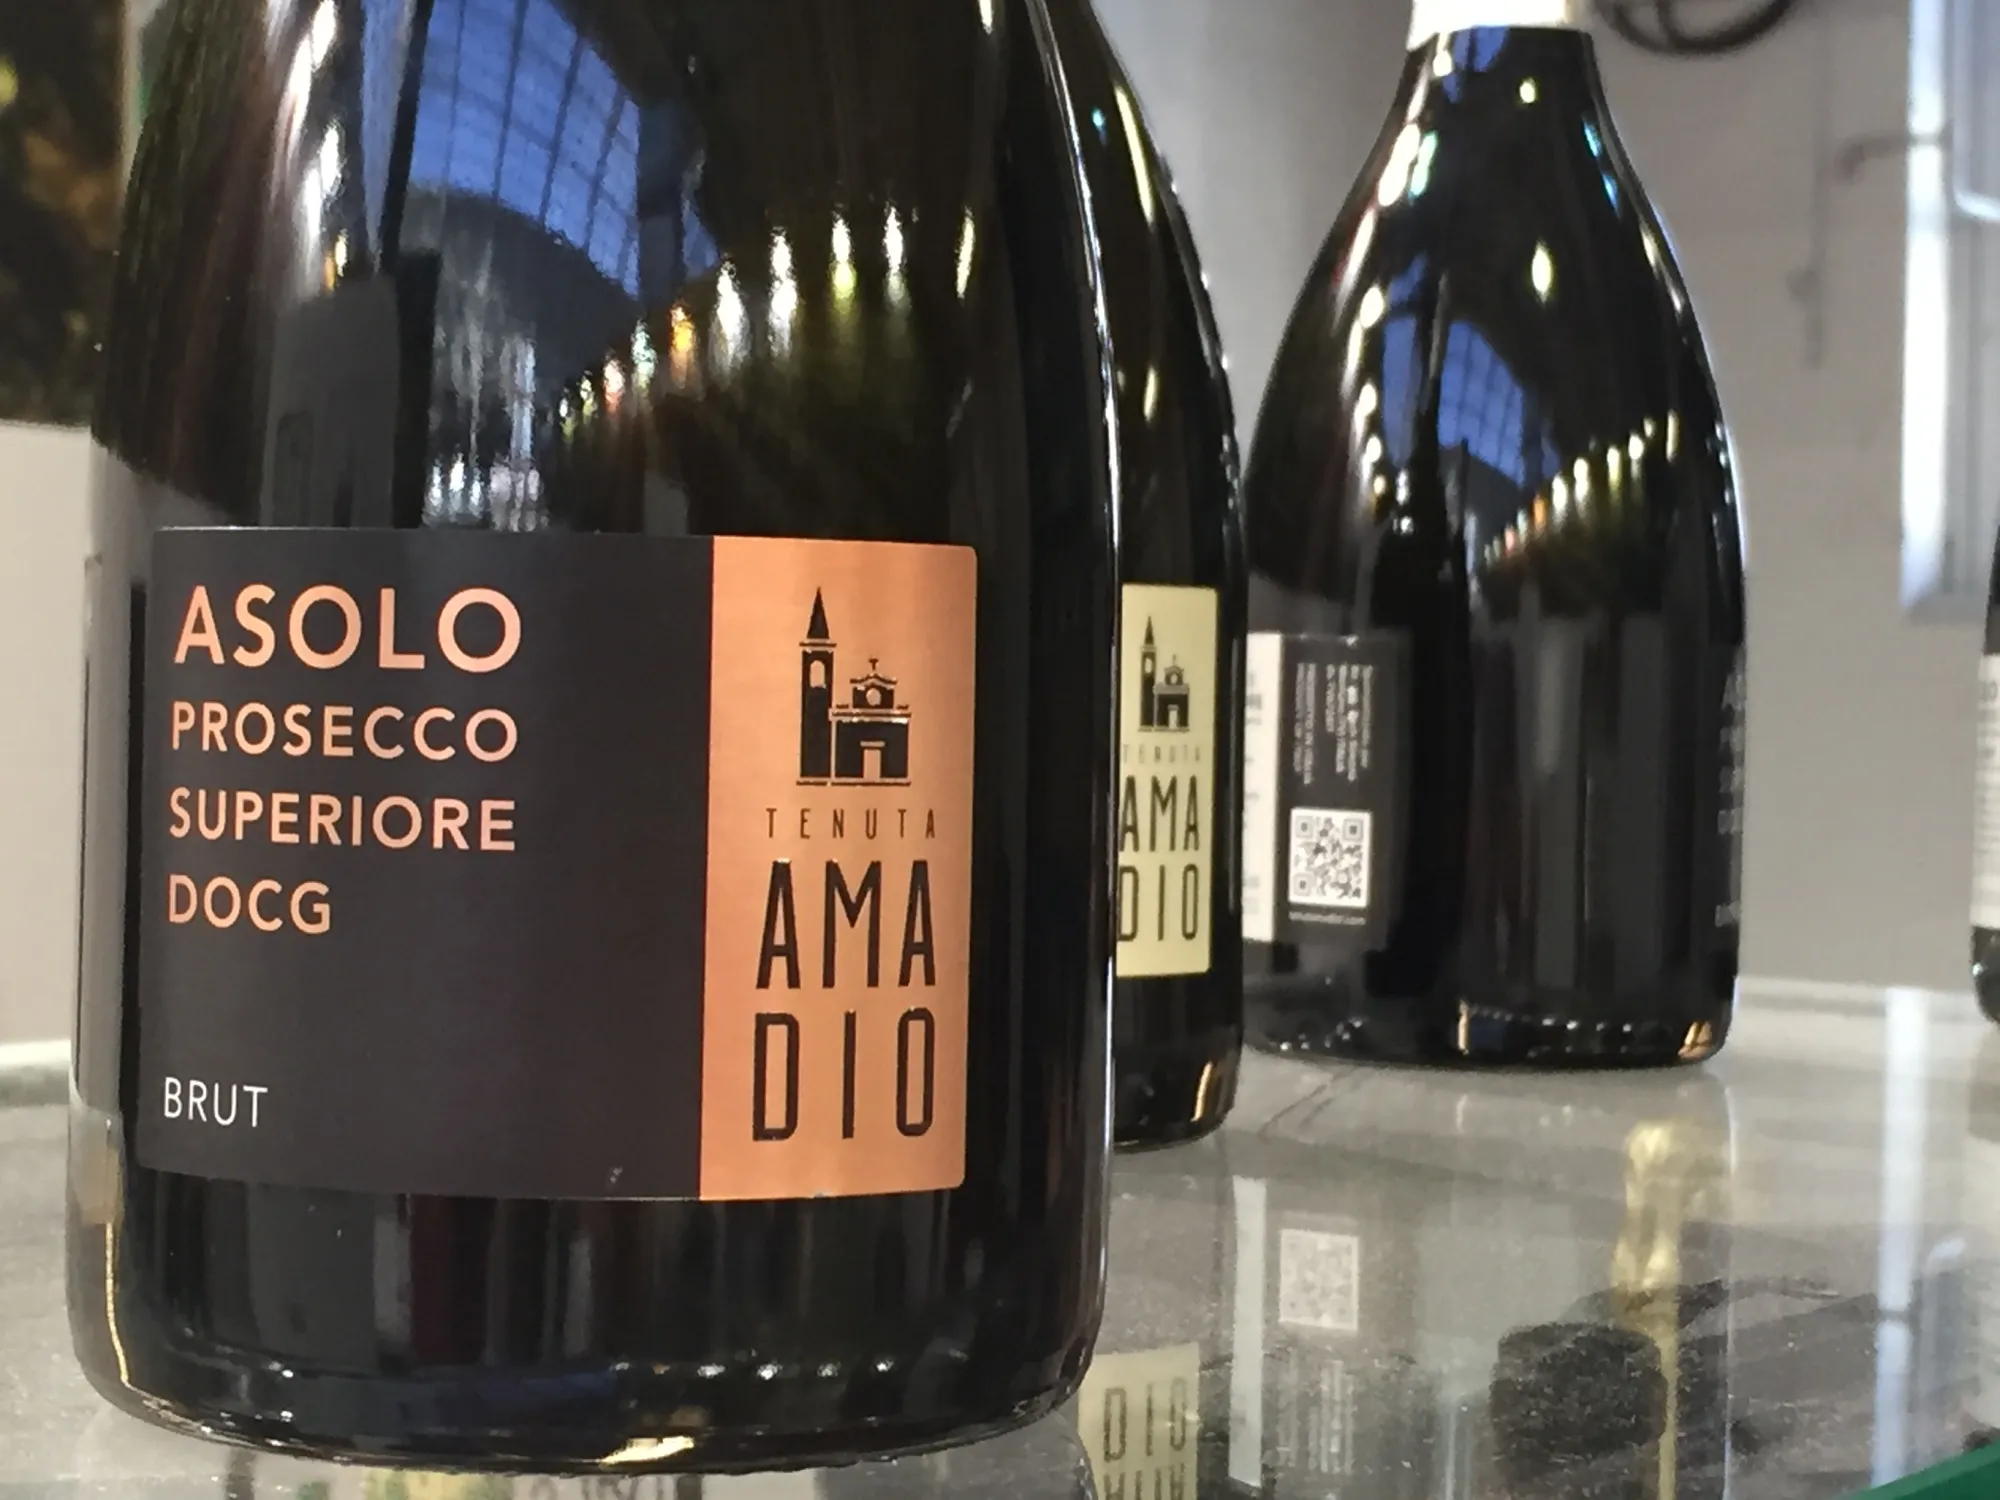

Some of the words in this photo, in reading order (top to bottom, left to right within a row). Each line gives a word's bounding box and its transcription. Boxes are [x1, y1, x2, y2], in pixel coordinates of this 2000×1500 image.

[174, 584, 521, 673] ASOLO
[172, 701, 517, 762] PROSECCO
[169, 787, 515, 851] SUPERIORE
[766, 807, 936, 841] TENUTA
[1119, 775, 1200, 852] AMA
[169, 874, 330, 934] DOCG
[755, 859, 936, 989] AMA
[1117, 864, 1199, 942] DIO
[164, 1076, 268, 1128] BRUT
[752, 1007, 936, 1142] DIO
